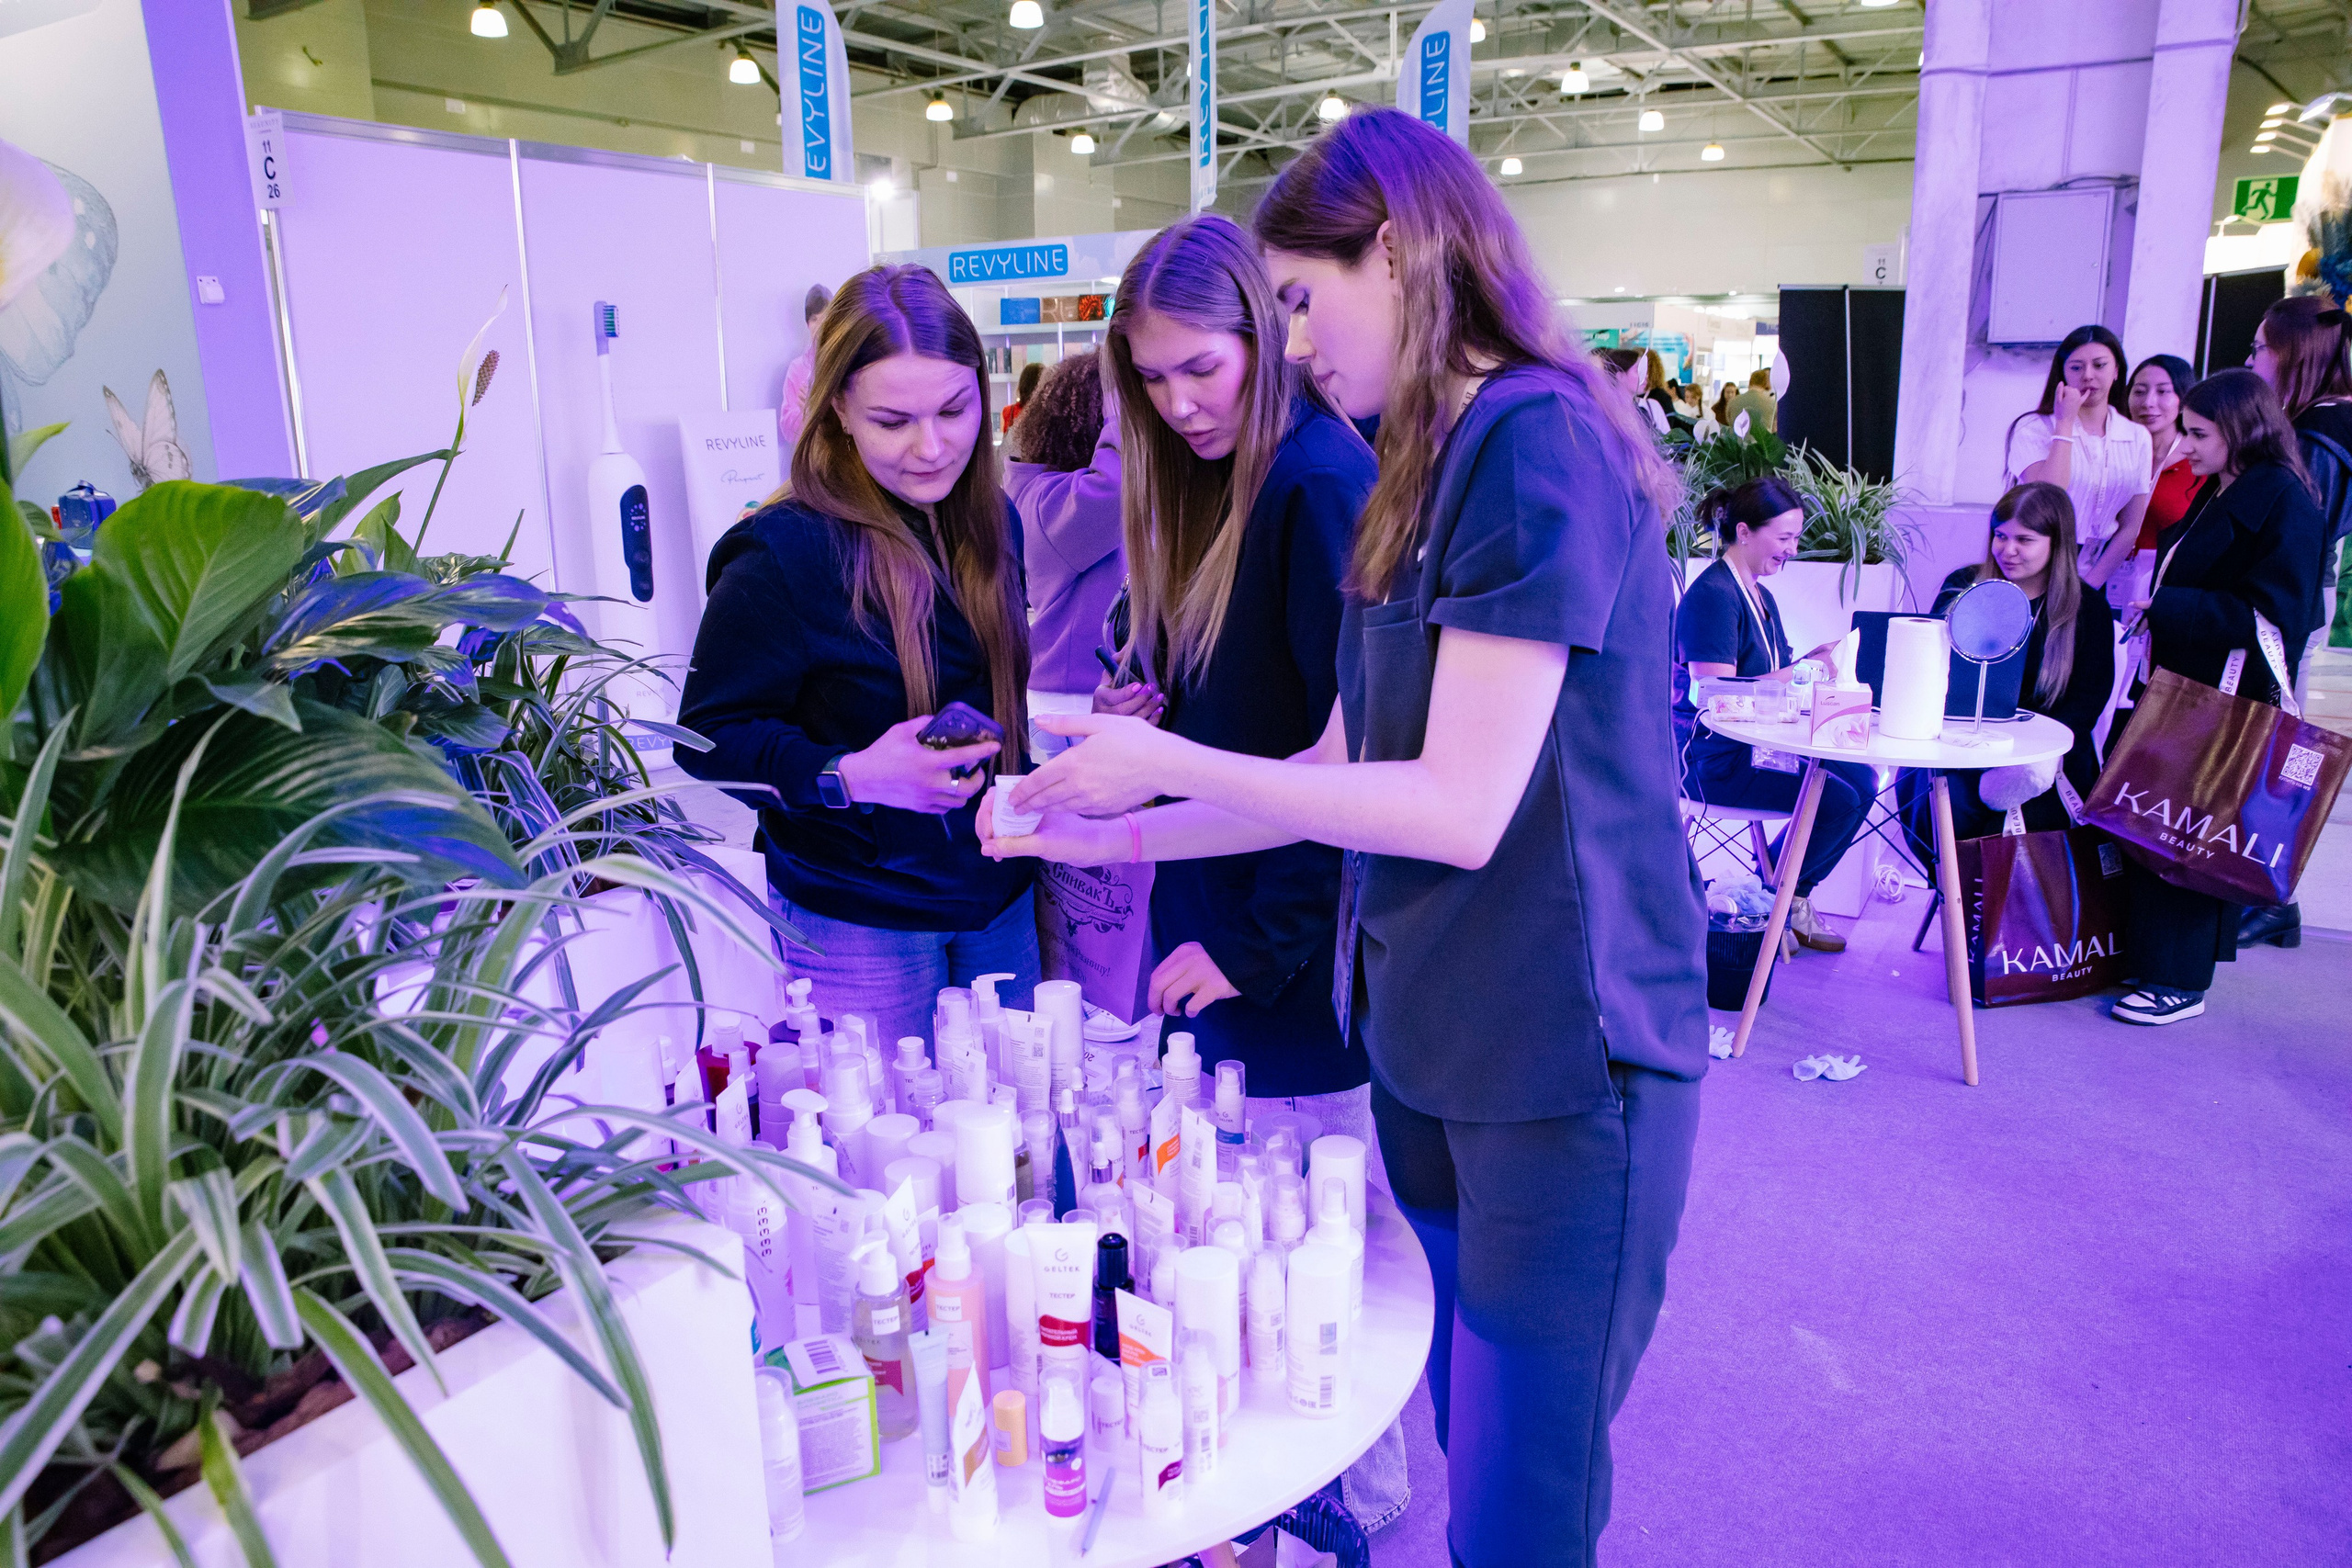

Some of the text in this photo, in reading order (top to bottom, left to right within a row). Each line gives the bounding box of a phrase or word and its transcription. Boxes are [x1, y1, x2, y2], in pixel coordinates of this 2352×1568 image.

[800, 12, 827, 173] EVYLINE
[1426, 38, 1447, 131] YLINE
[263, 139, 272, 153] 11
[265, 156, 277, 180] C
[267, 183, 281, 198] 26
[953, 249, 1064, 278] REVYLINE
[1875, 266, 1887, 279] C
[706, 434, 767, 451] REVYLINE
[2224, 656, 2240, 693] BEAUTY
[2010, 807, 2022, 834] BEAU
[2114, 782, 2285, 868] KAMALI
[2159, 832, 2215, 859] BEAUTY
[1968, 878, 1984, 964] KAMALI
[2002, 932, 2124, 975] KAMAL
[2052, 965, 2093, 982] BEAUTY
[873, 1315, 899, 1325] ТЕСТЕР
[935, 1303, 961, 1312] ТЕСТЕР
